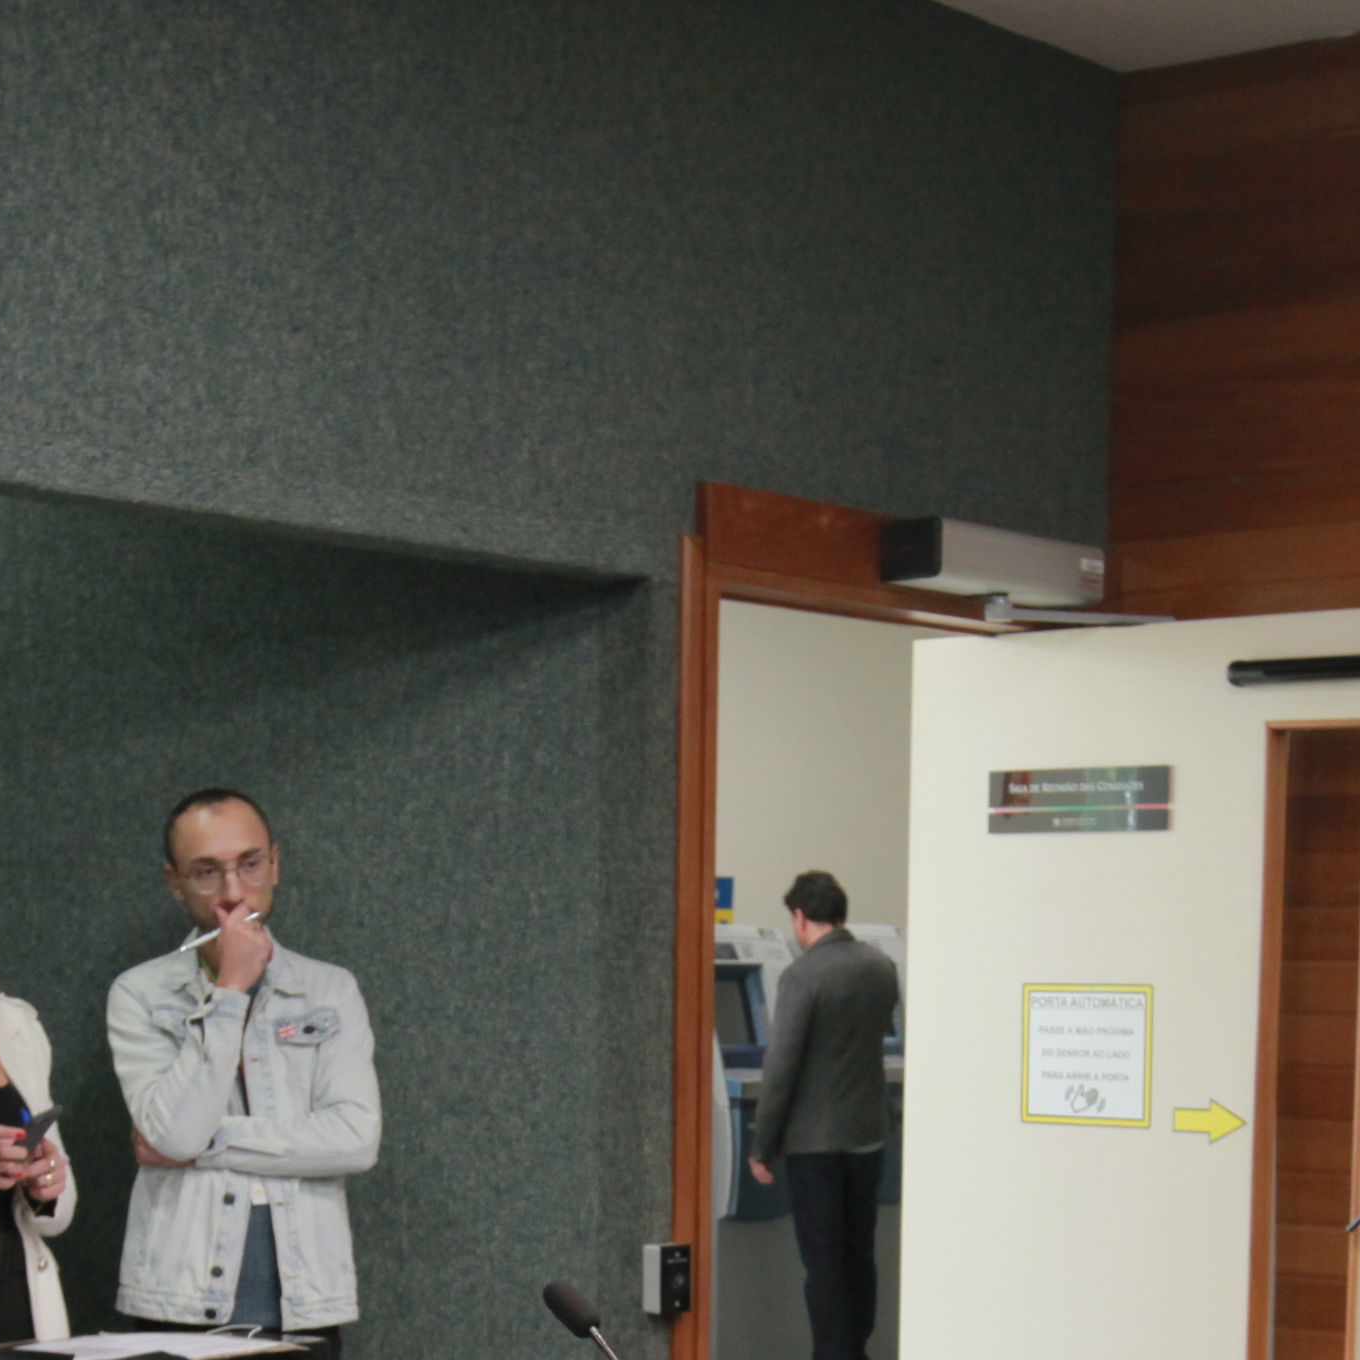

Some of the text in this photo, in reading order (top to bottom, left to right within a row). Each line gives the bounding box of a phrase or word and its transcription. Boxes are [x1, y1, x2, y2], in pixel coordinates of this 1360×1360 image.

[1031, 994, 1144, 1009] PORTA AUTOMÁTICA
[1039, 1025, 1065, 1034] PASSE
[1075, 1025, 1095, 1034] MÃO
[1042, 1047, 1131, 1059] DO SENSOR AO LADO
[1042, 1070, 1064, 1079] PARA
[1066, 1071, 1092, 1080] ABRIR
[1101, 1072, 1130, 1081] PORTA
